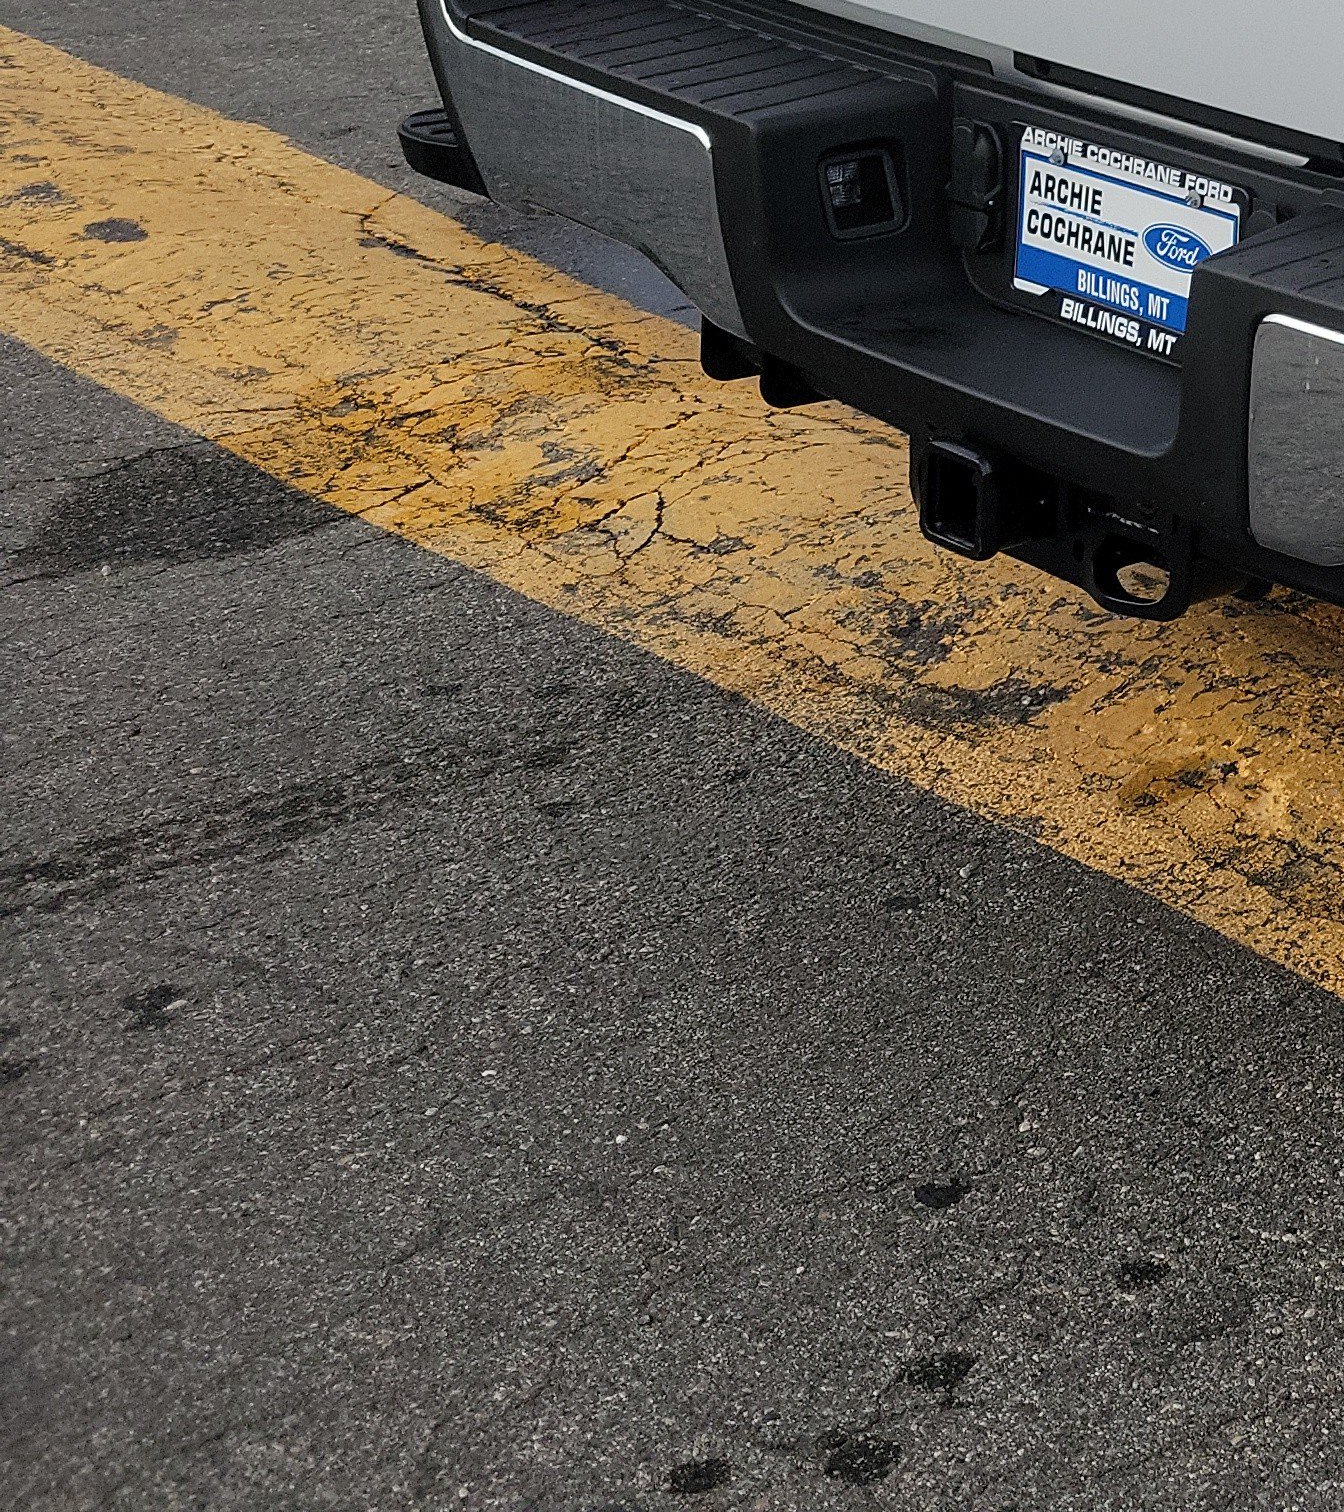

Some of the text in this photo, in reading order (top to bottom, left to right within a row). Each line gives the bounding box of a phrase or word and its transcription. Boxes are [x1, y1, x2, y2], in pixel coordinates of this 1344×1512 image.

[1019, 126, 1234, 204] ARCHIE COCHRANE FORD
[1028, 170, 1104, 217] ARCHIE
[1026, 208, 1137, 268] COCHRANE
[1155, 229, 1200, 267] Ford
[1076, 268, 1170, 321] BILLINGS, MT
[1059, 297, 1178, 356] BILLINGS, MT
